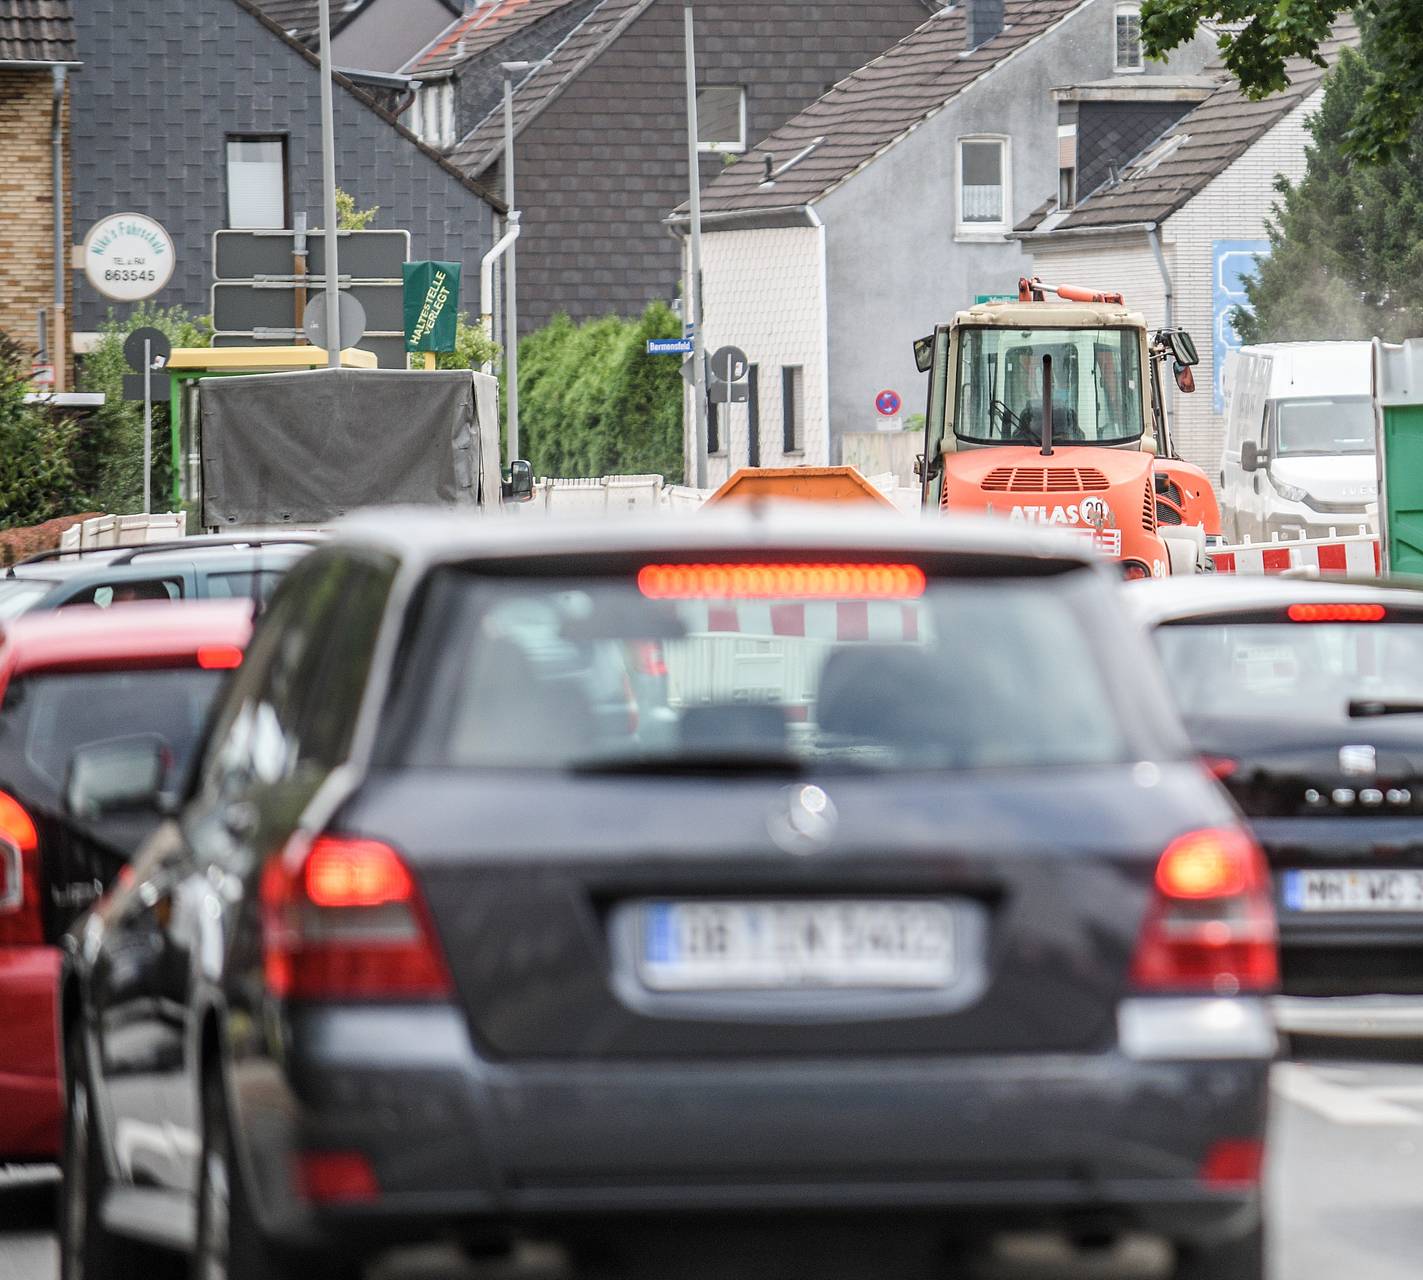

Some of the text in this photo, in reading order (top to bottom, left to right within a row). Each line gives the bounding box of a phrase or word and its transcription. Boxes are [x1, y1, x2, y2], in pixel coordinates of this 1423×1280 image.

[105, 269, 155, 281] 863545
[410, 270, 446, 345] HALTESTELLE
[423, 286, 450, 335] VERLEGT
[1009, 504, 1080, 525] ATLAS
